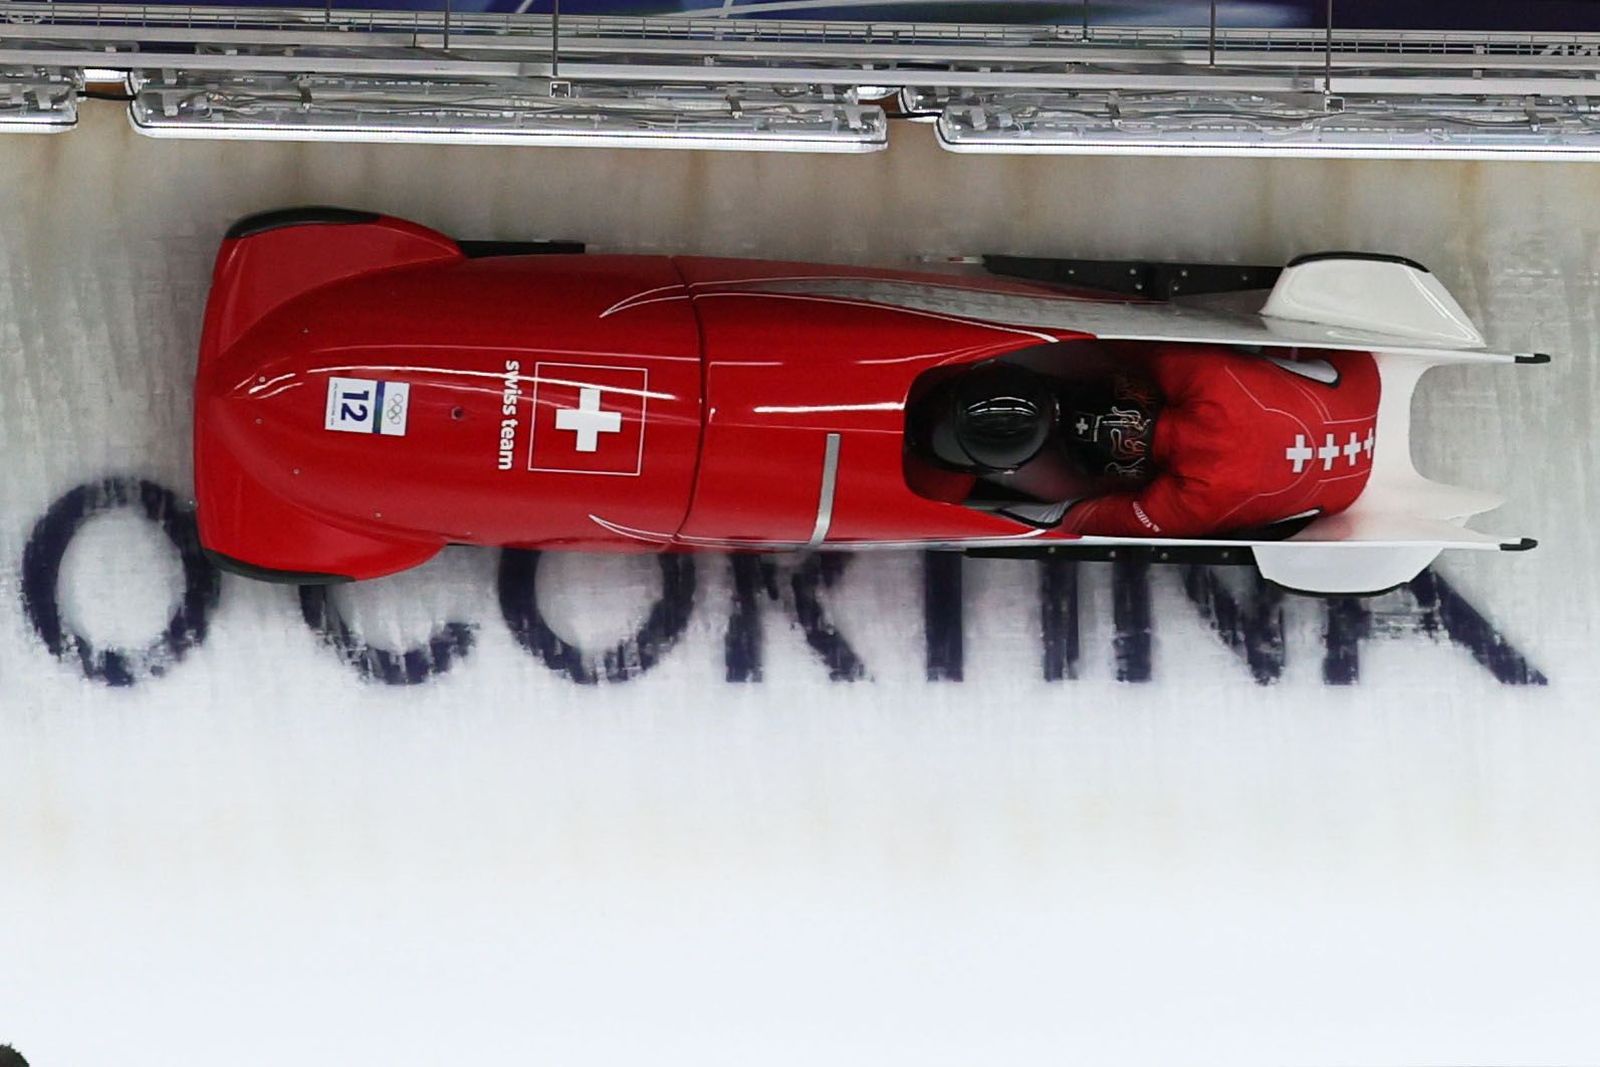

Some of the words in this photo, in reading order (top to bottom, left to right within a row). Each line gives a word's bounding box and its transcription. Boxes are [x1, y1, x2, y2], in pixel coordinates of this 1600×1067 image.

[340, 389, 369, 422] 12
[502, 360, 521, 415] swiss
[498, 418, 518, 470] team
